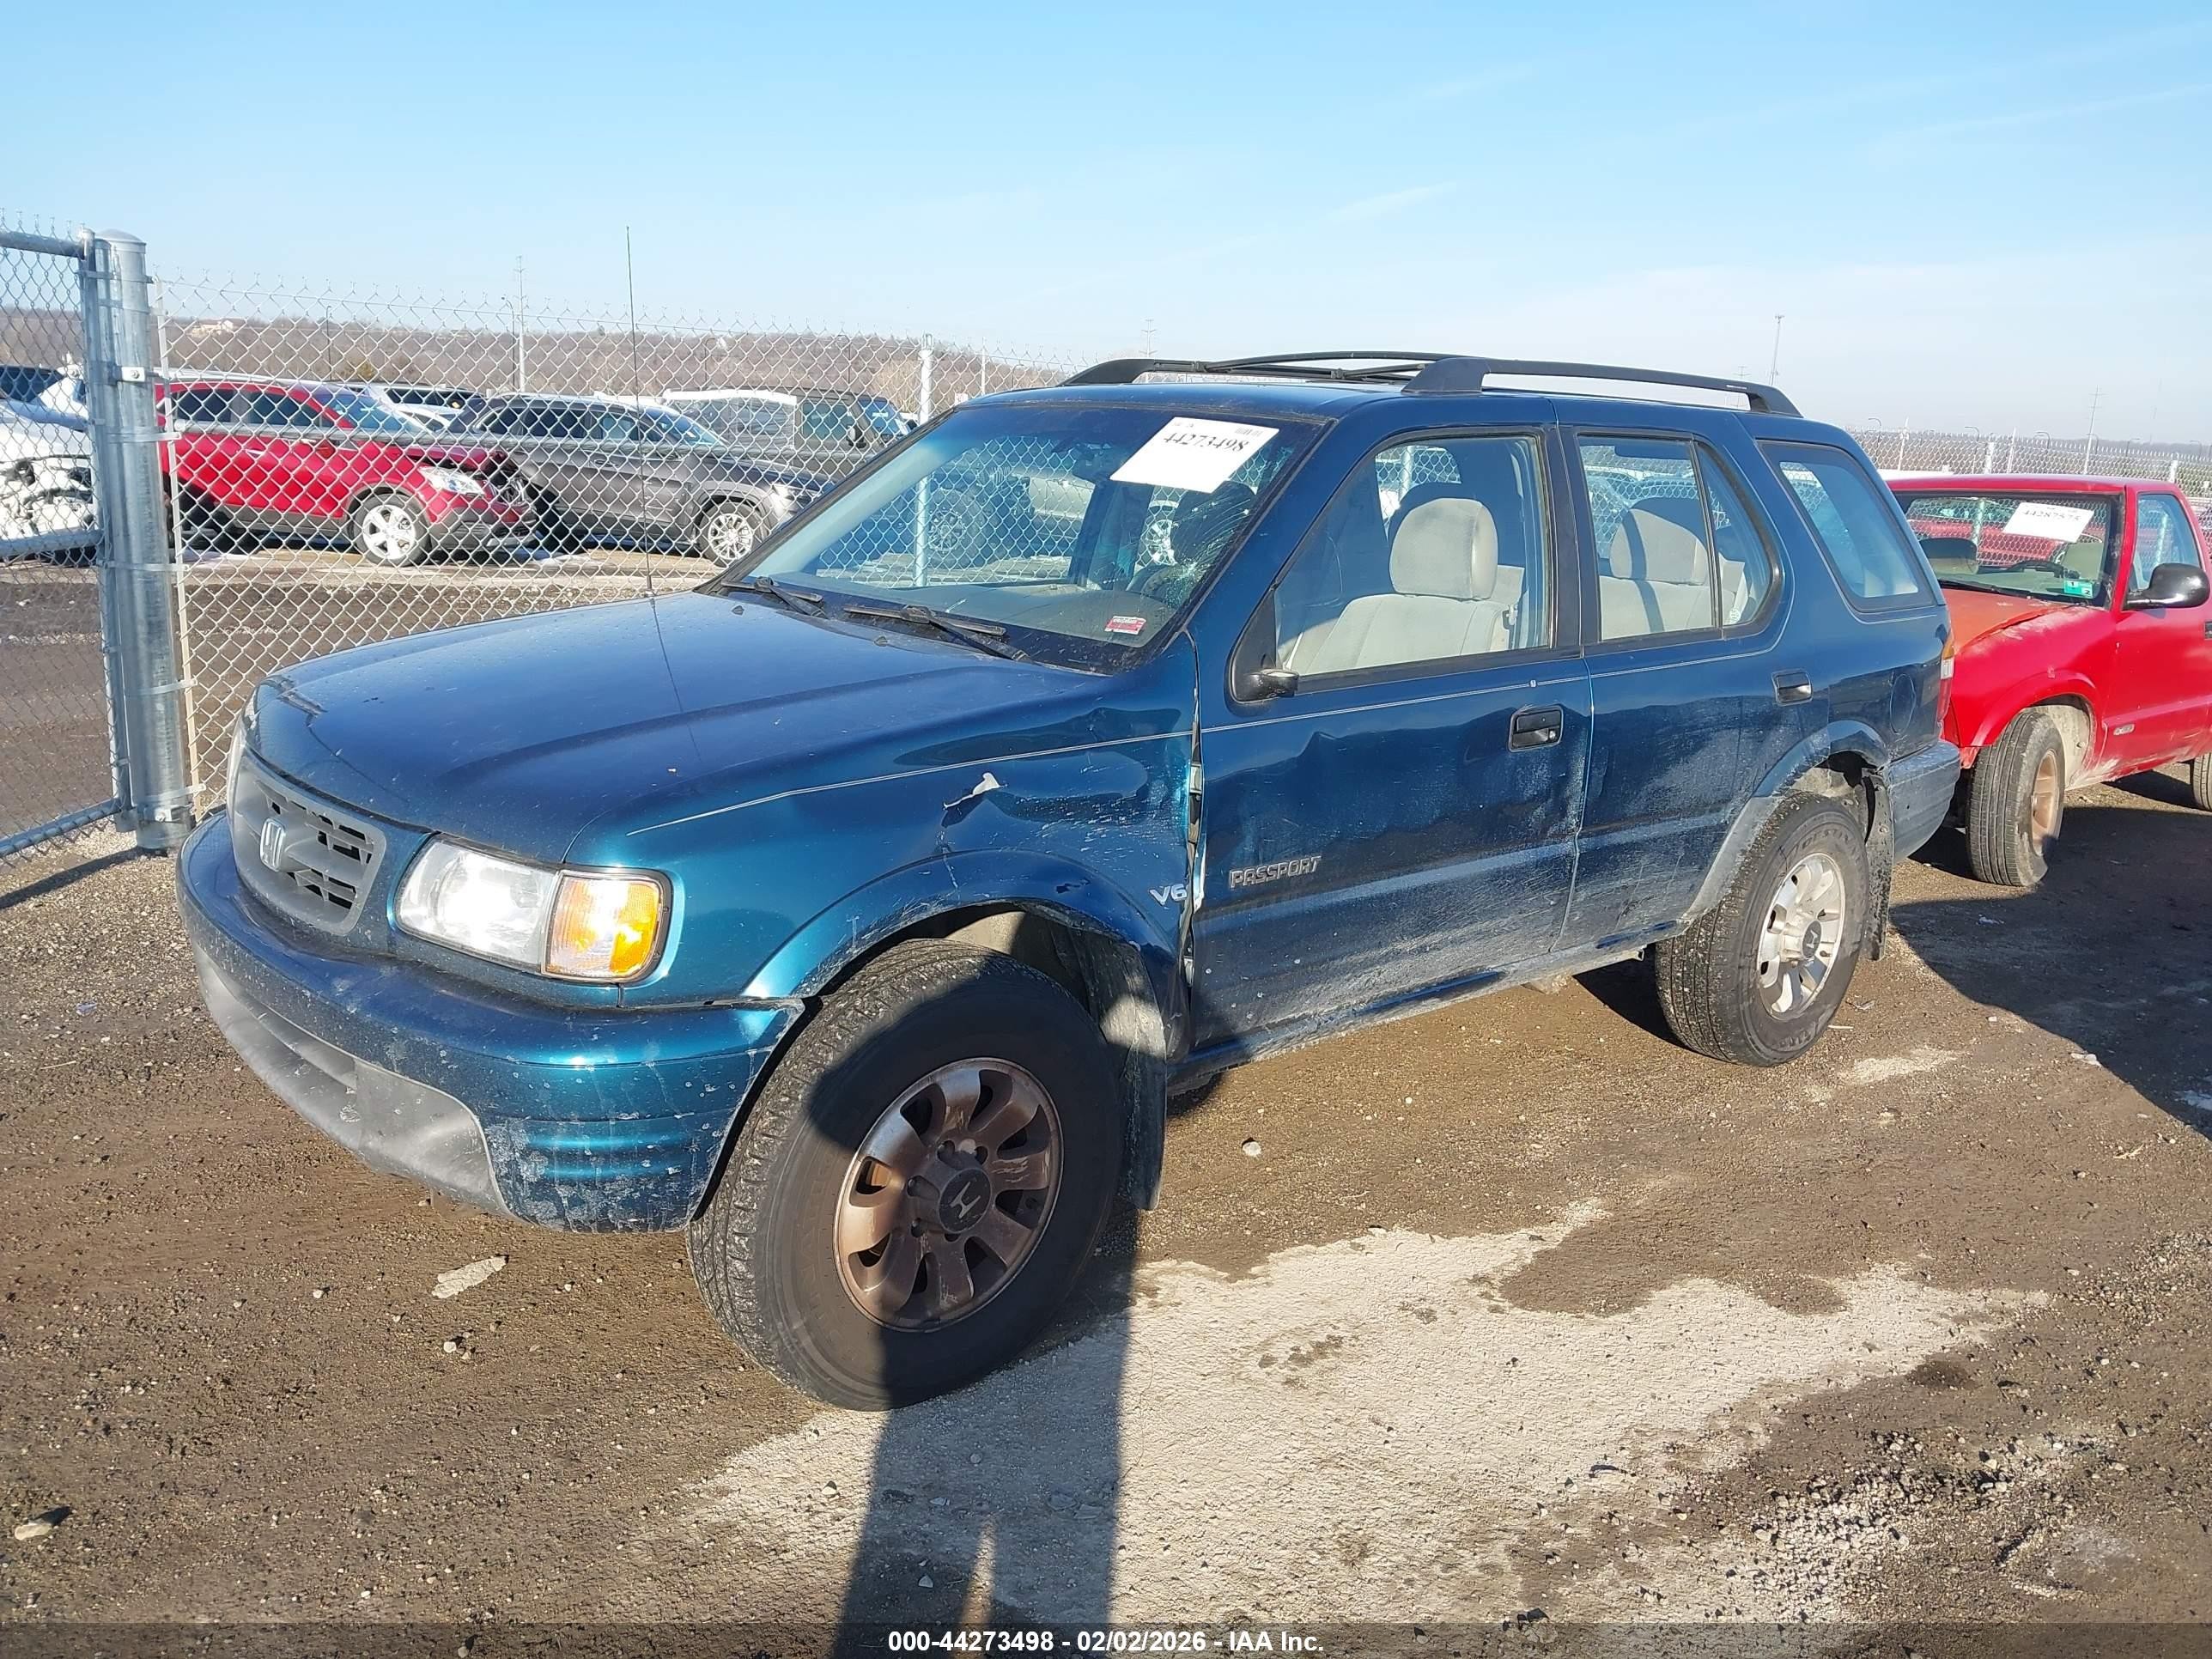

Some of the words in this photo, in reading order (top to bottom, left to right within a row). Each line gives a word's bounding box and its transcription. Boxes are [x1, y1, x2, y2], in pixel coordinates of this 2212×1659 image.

[1164, 432, 1249, 452] 44273498
[1230, 856, 1322, 889] PASSPORT
[1149, 884, 1188, 906] V6
